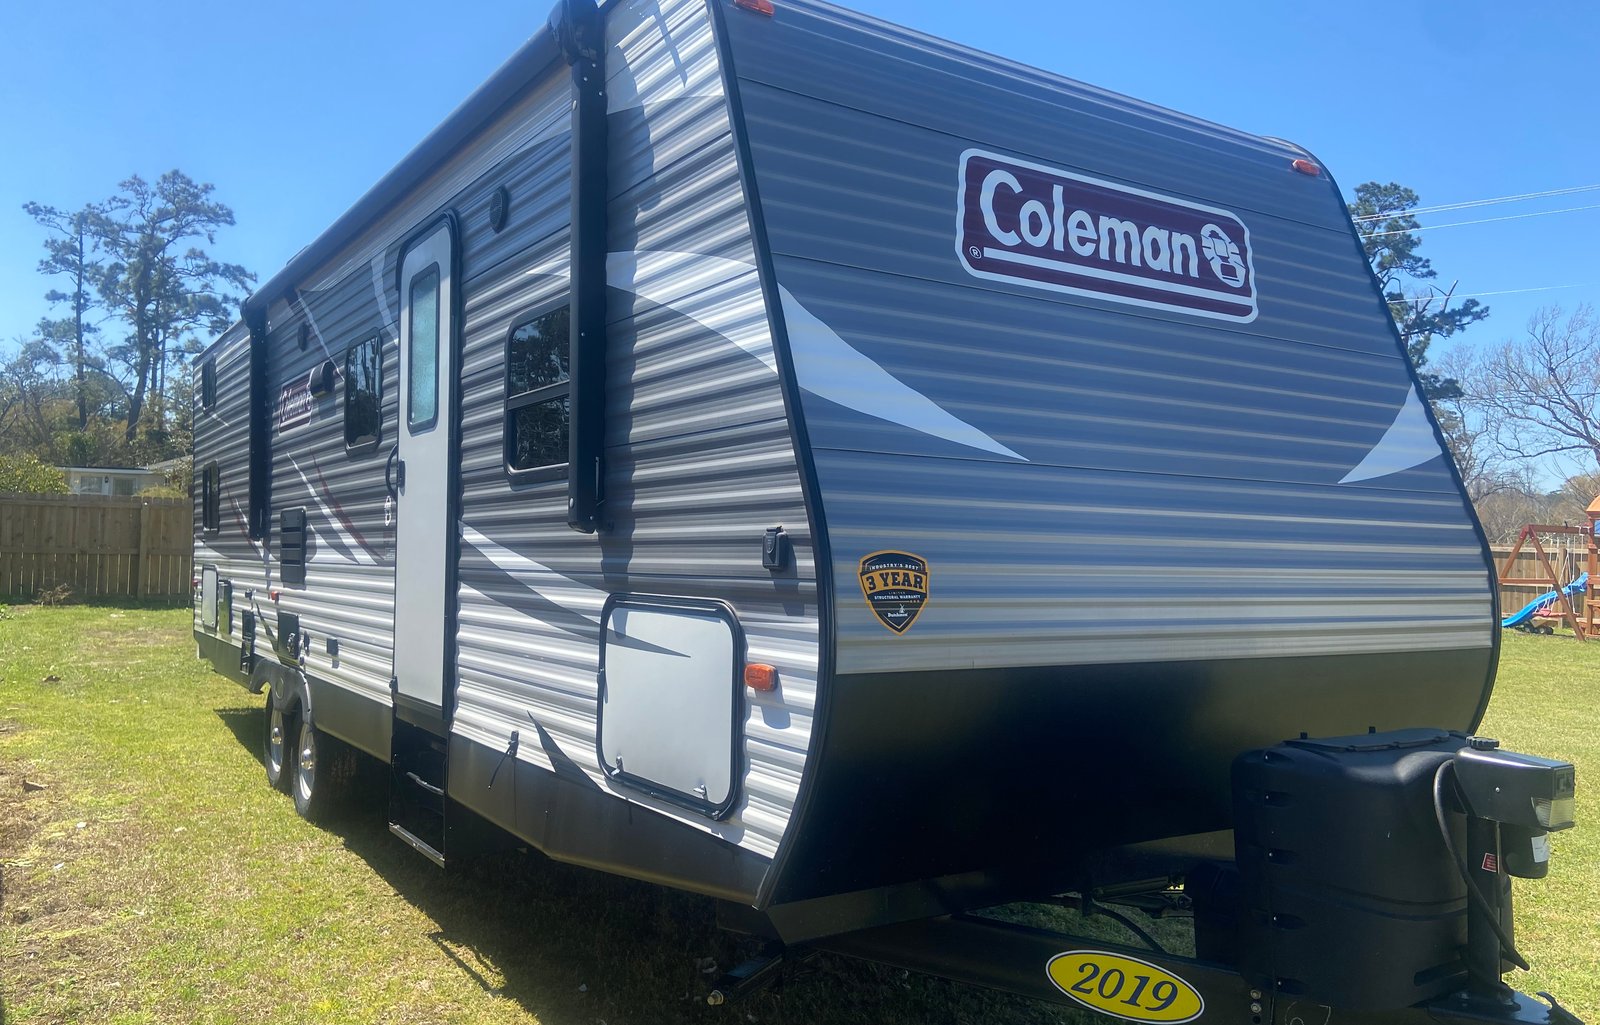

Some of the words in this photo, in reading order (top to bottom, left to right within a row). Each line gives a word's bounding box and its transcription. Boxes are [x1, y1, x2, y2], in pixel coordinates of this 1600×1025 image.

[980, 169, 1199, 278] Coleman
[866, 576, 876, 590] 3
[880, 572, 923, 589] YEAR
[1070, 962, 1179, 1012] 2019
